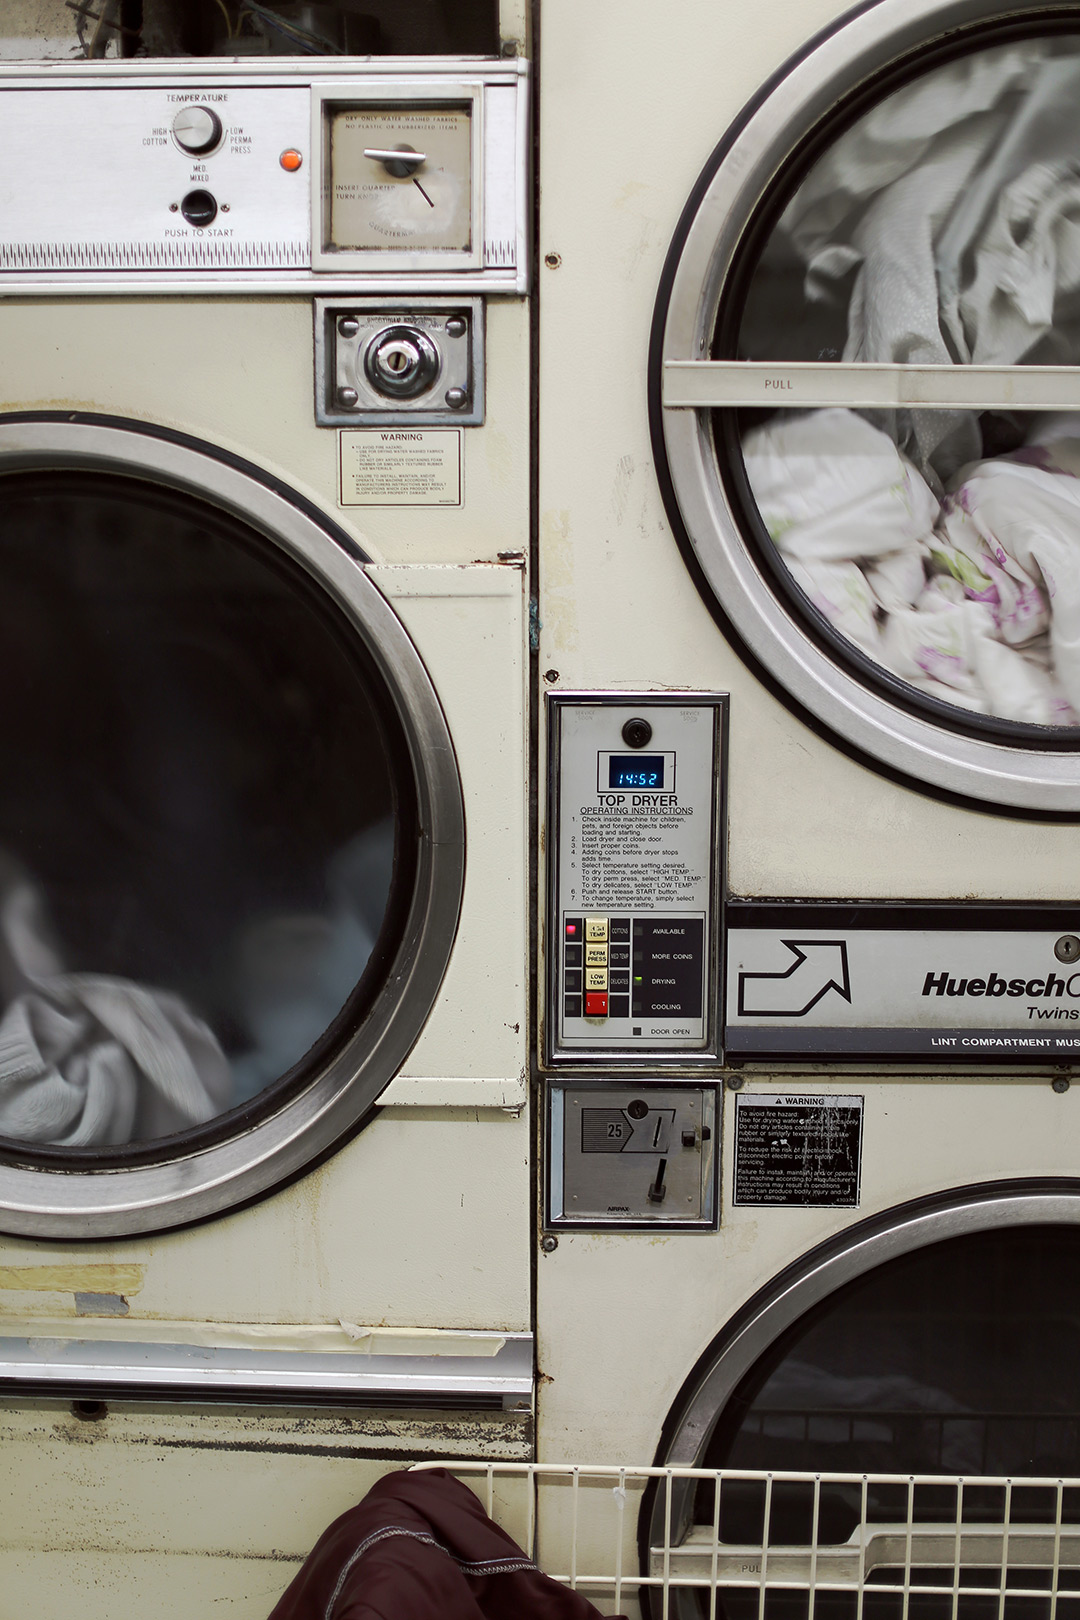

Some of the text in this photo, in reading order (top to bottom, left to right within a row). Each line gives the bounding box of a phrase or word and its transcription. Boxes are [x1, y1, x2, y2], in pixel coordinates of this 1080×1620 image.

[165, 228, 233, 237] PUSH TO START
[765, 380, 792, 389] PULL
[620, 774, 656, 785] 14:52
[597, 795, 678, 806] TOP DRYER
[608, 1124, 622, 1137] 25
[741, 1565, 767, 1573] PUL
